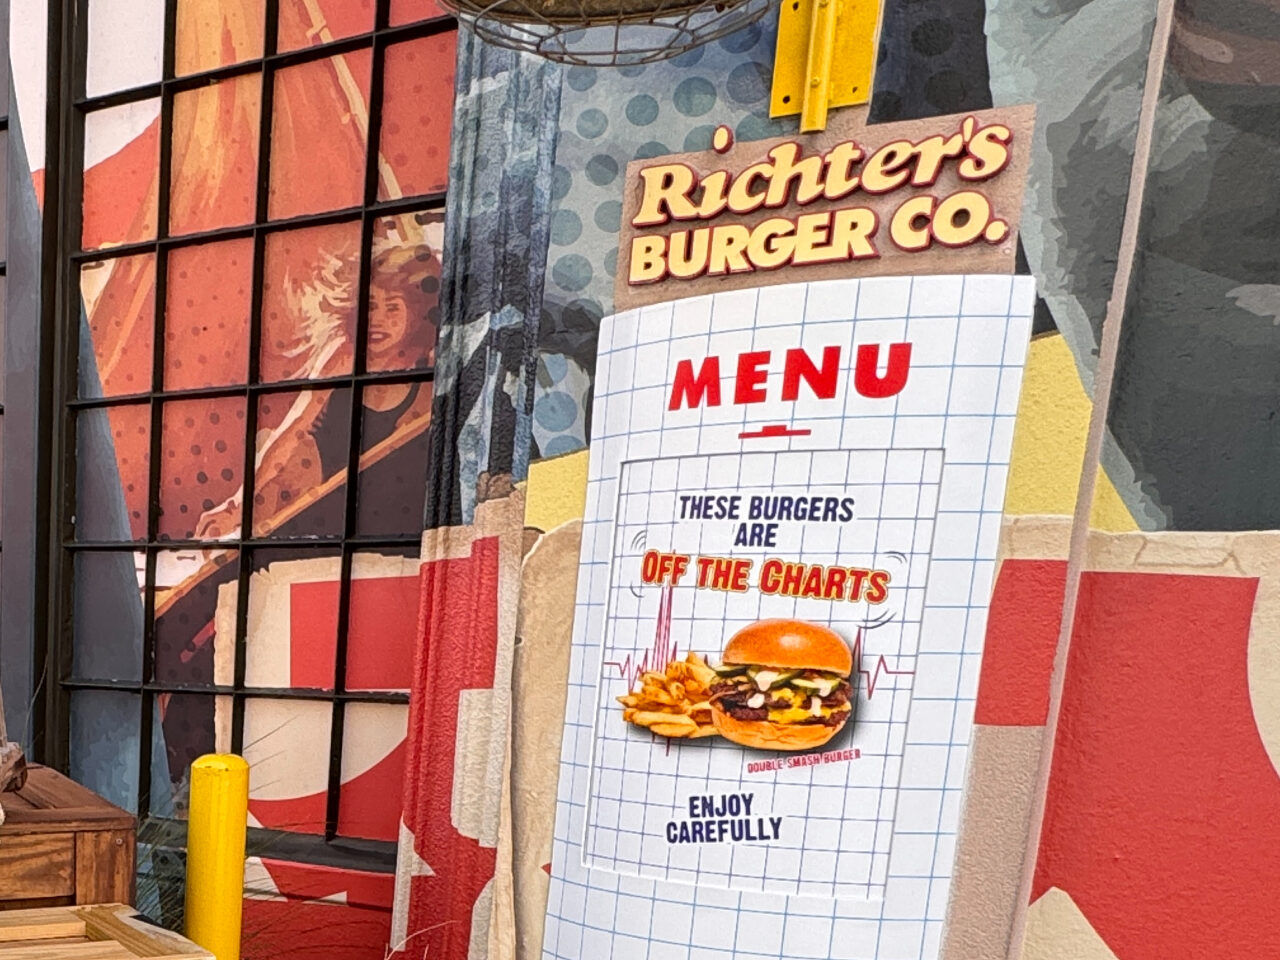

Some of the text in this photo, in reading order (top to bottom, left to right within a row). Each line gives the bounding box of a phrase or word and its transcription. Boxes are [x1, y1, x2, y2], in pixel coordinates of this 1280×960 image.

[631, 116, 1013, 229] Richter's
[628, 191, 1011, 285] BURGER CO.
[668, 342, 913, 411] MENU
[680, 495, 855, 522] THESE BURGERS
[733, 522, 779, 548] ARE
[641, 549, 892, 605] OFF THE CHARTS
[747, 748, 861, 774] DOUBLE SMASH BURGER
[688, 792, 754, 818] ENJOY
[666, 817, 783, 844] CAREFULLY
